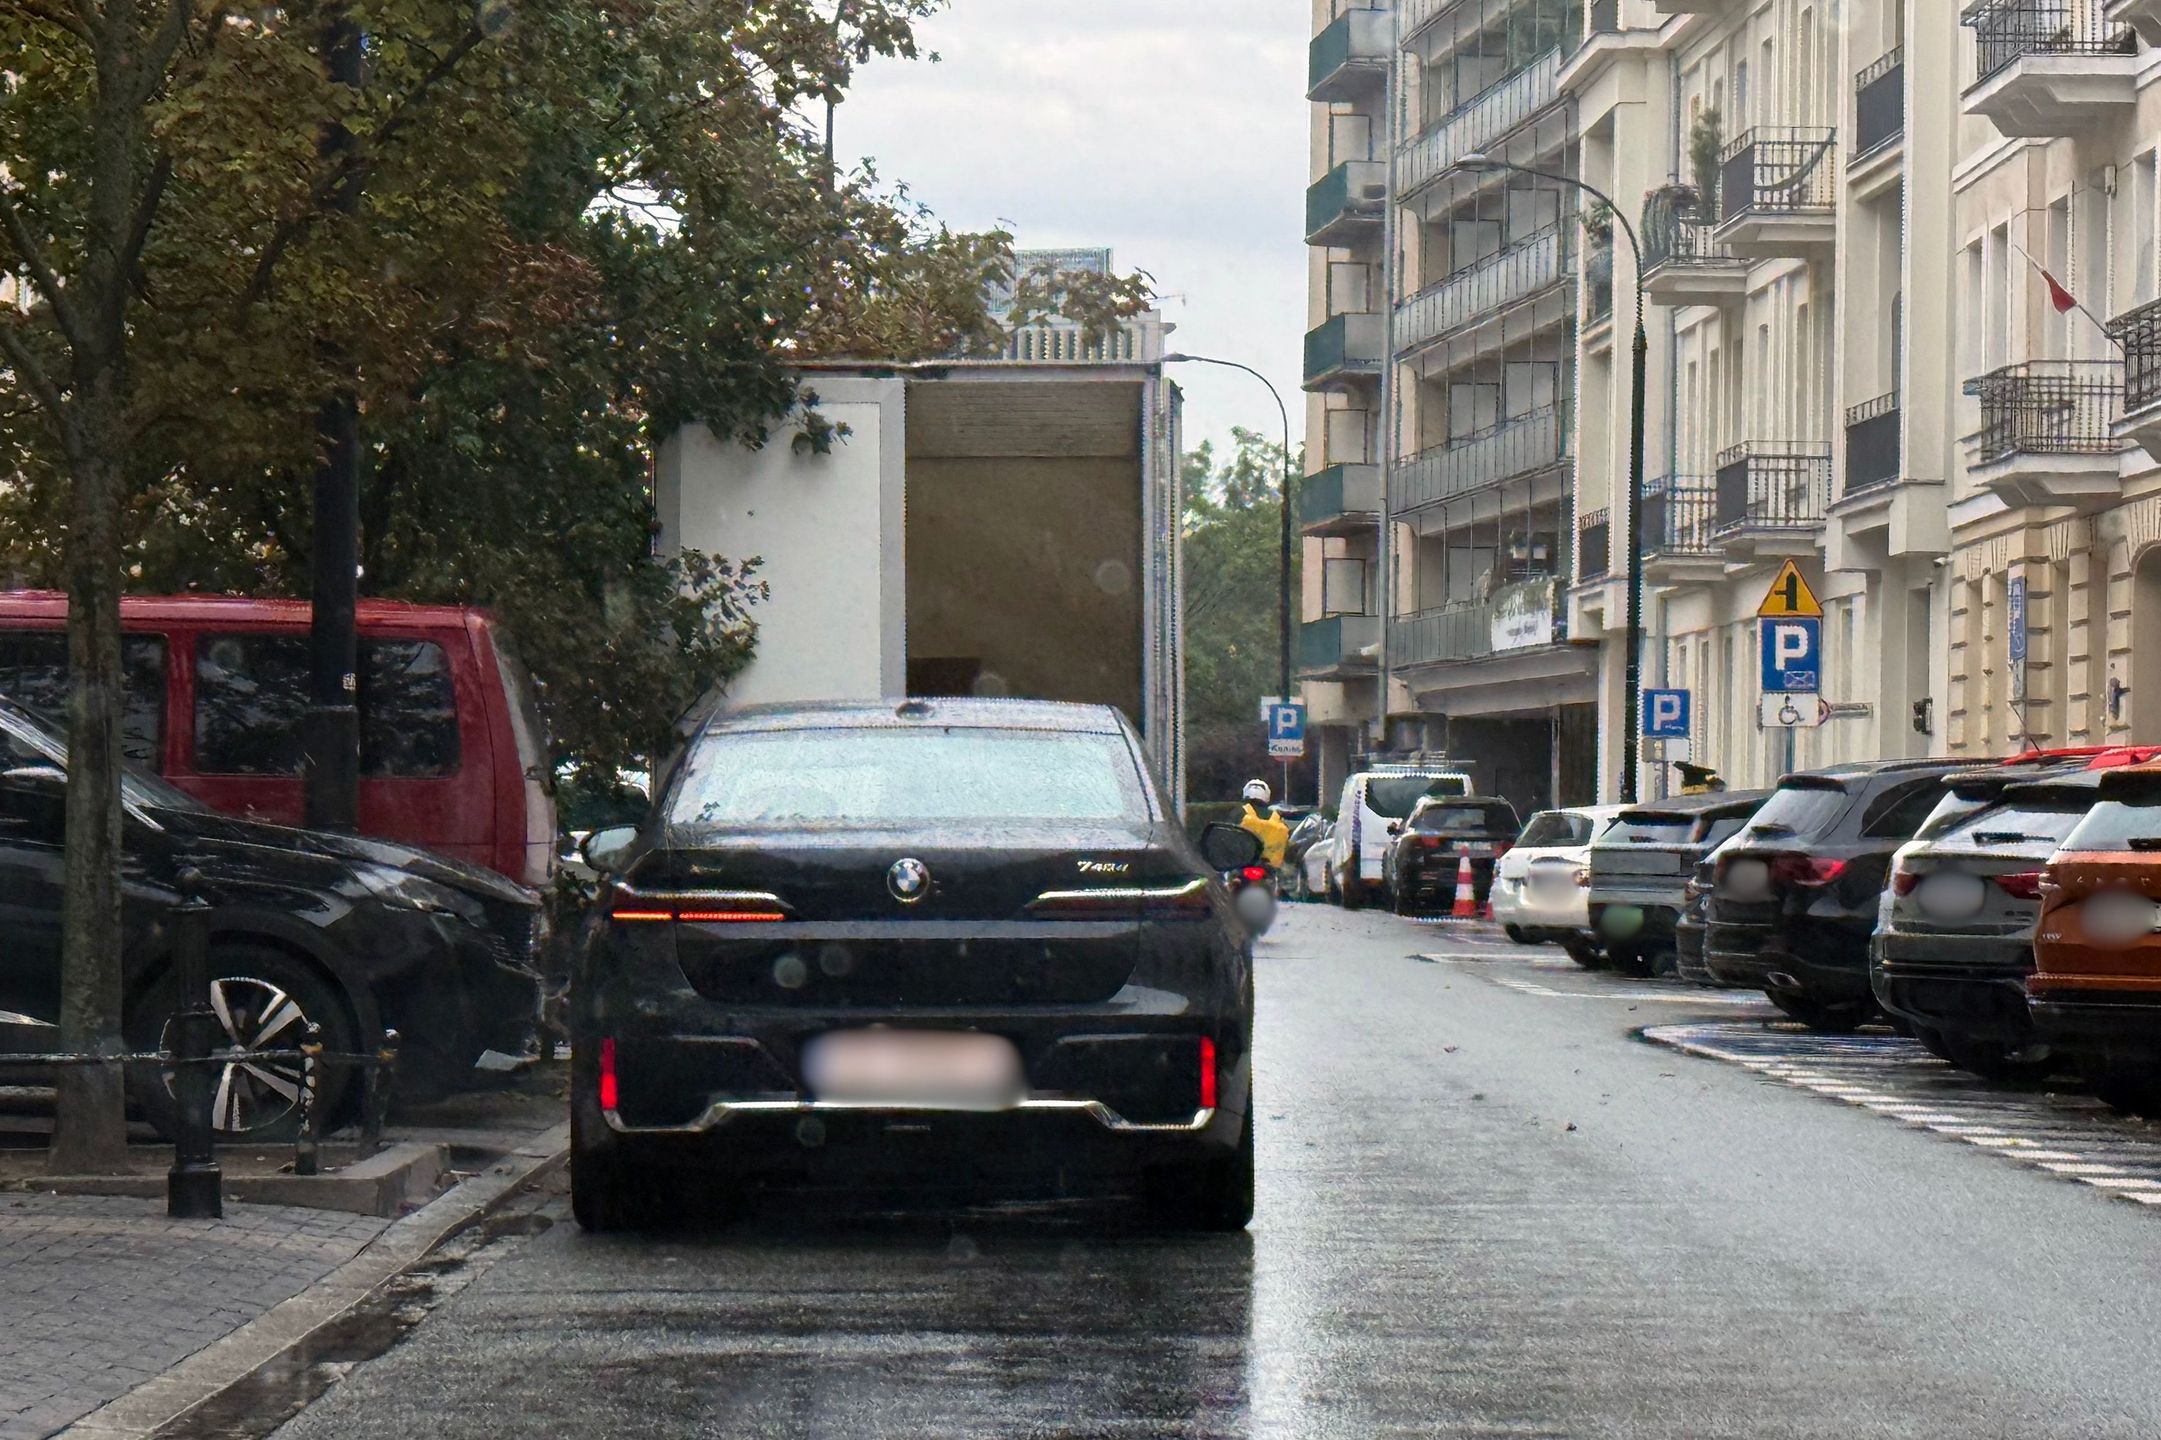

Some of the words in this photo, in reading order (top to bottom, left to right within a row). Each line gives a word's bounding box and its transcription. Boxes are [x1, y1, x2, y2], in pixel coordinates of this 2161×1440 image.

[1775, 625, 1808, 670] P
[1277, 707, 1297, 735] P
[1653, 694, 1681, 731] P
